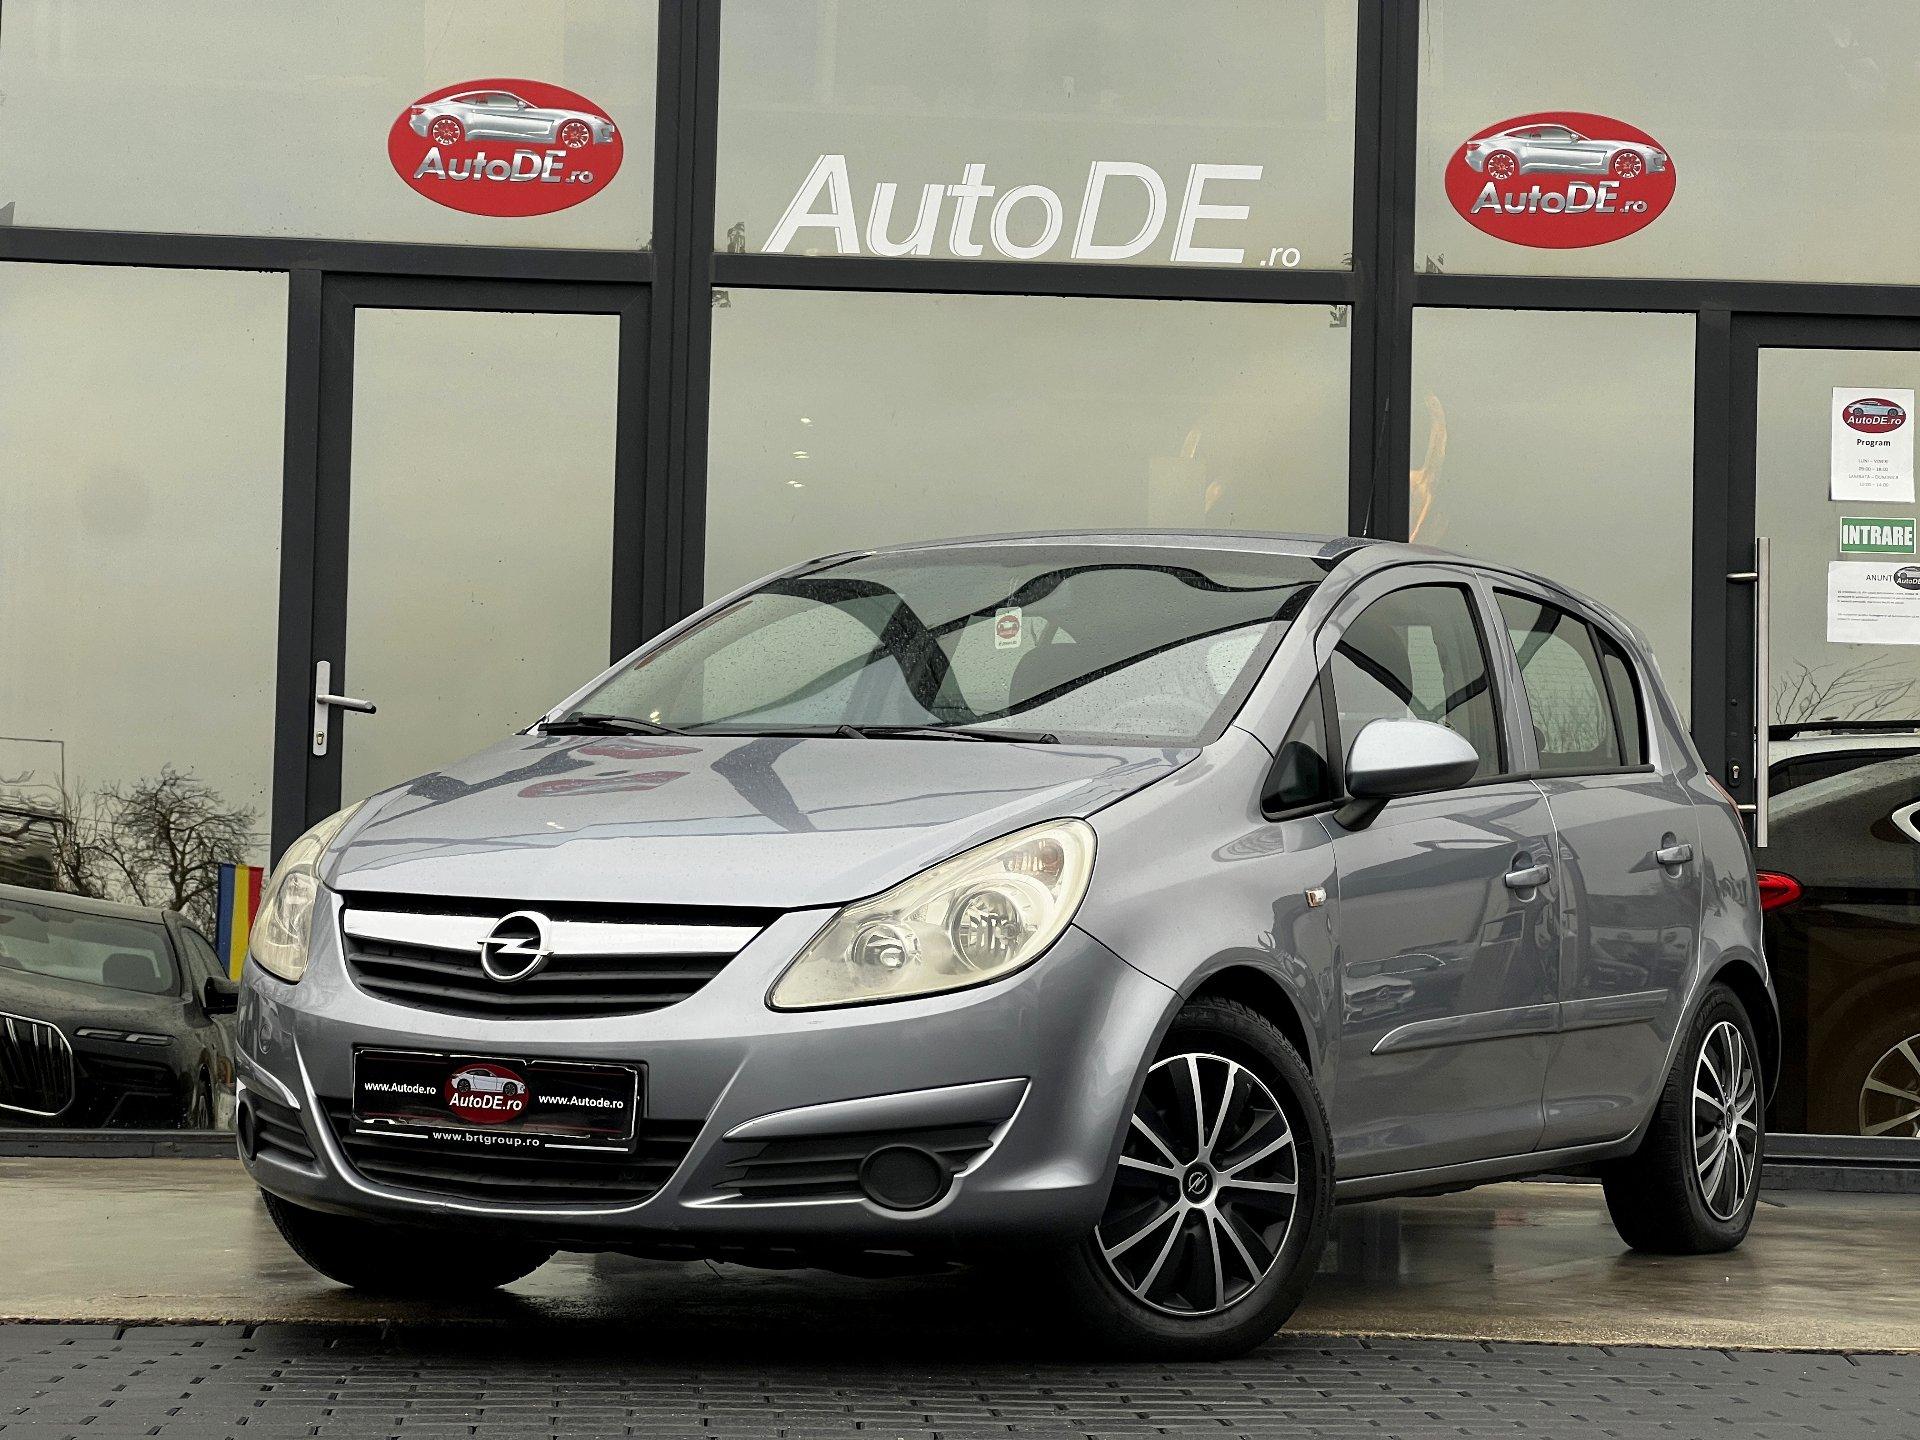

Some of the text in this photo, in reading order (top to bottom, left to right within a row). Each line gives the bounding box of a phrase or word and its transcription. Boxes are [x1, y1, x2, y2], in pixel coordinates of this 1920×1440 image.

[1847, 415, 1902, 425] AutoDE.ro
[1856, 438, 1891, 448] Program
[1842, 525, 1913, 546] INTRARE
[364, 1082, 437, 1095] www.Autode.ro
[449, 1092, 523, 1111] AutoDE.ro
[538, 1095, 624, 1109] www.Autode.ro
[432, 1131, 540, 1147] www.brtgroup.ro
